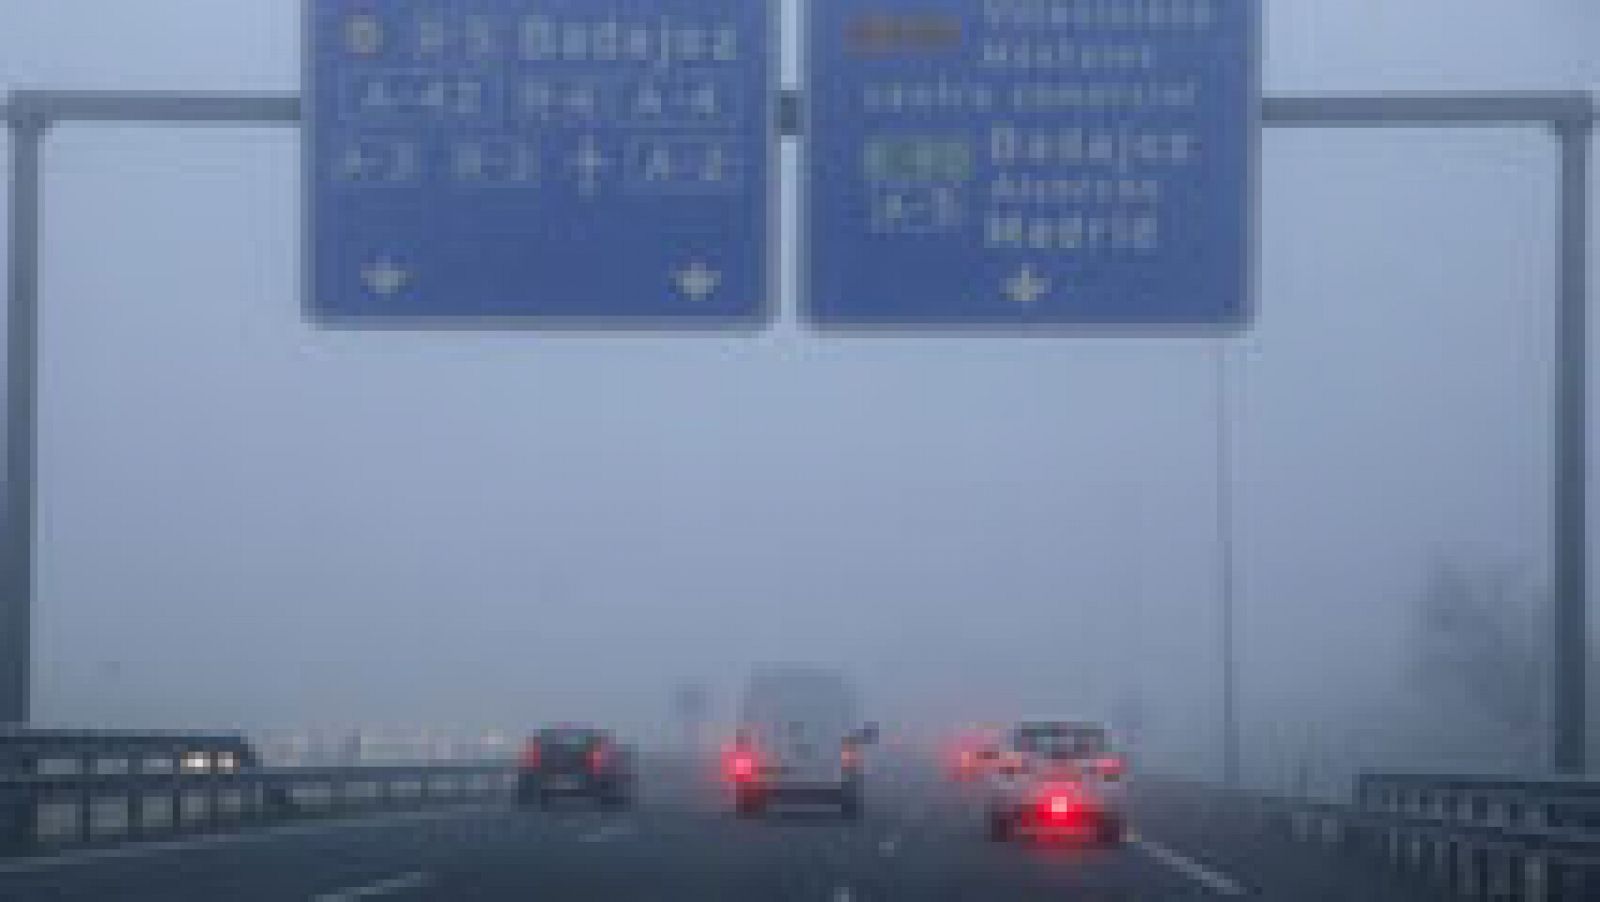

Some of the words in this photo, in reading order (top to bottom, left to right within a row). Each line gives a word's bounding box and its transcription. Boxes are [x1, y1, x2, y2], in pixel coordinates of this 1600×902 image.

[519, 15, 737, 67] Badajoz
[990, 126, 1194, 172] Badajoz
[985, 211, 1160, 248] Madrid
